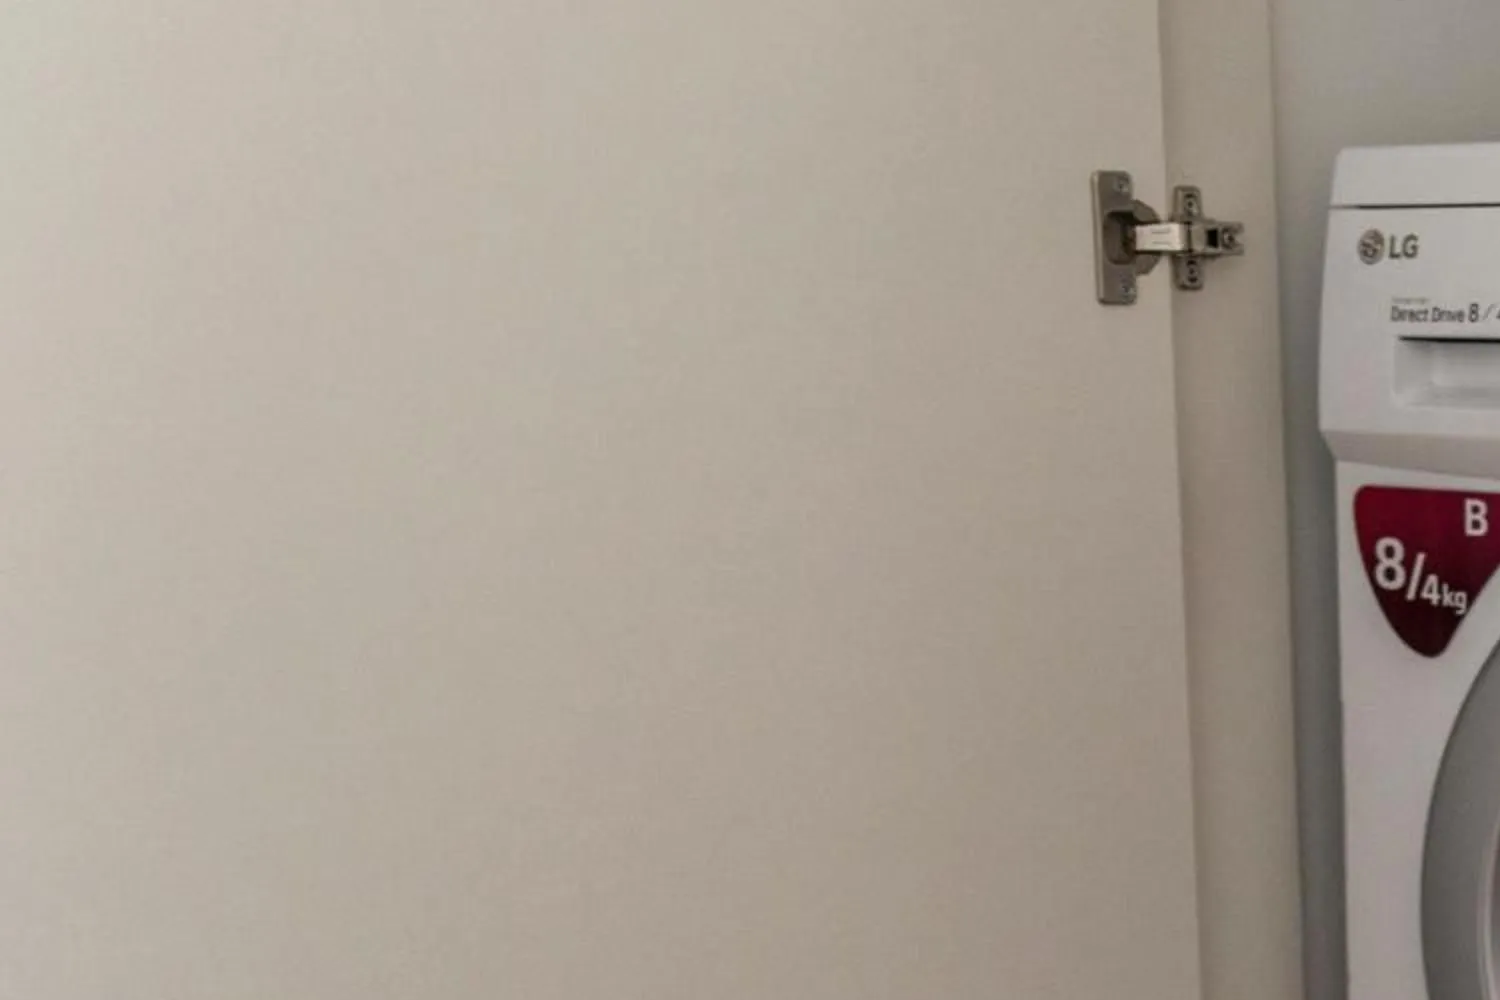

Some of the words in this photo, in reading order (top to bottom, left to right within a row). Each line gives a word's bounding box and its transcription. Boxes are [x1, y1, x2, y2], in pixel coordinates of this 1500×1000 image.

[1388, 233, 1419, 259] LG
[1391, 305, 1429, 323] Direct
[1431, 306, 1465, 323] Drive
[1468, 302, 1480, 324] 8
[1464, 498, 1489, 536] B
